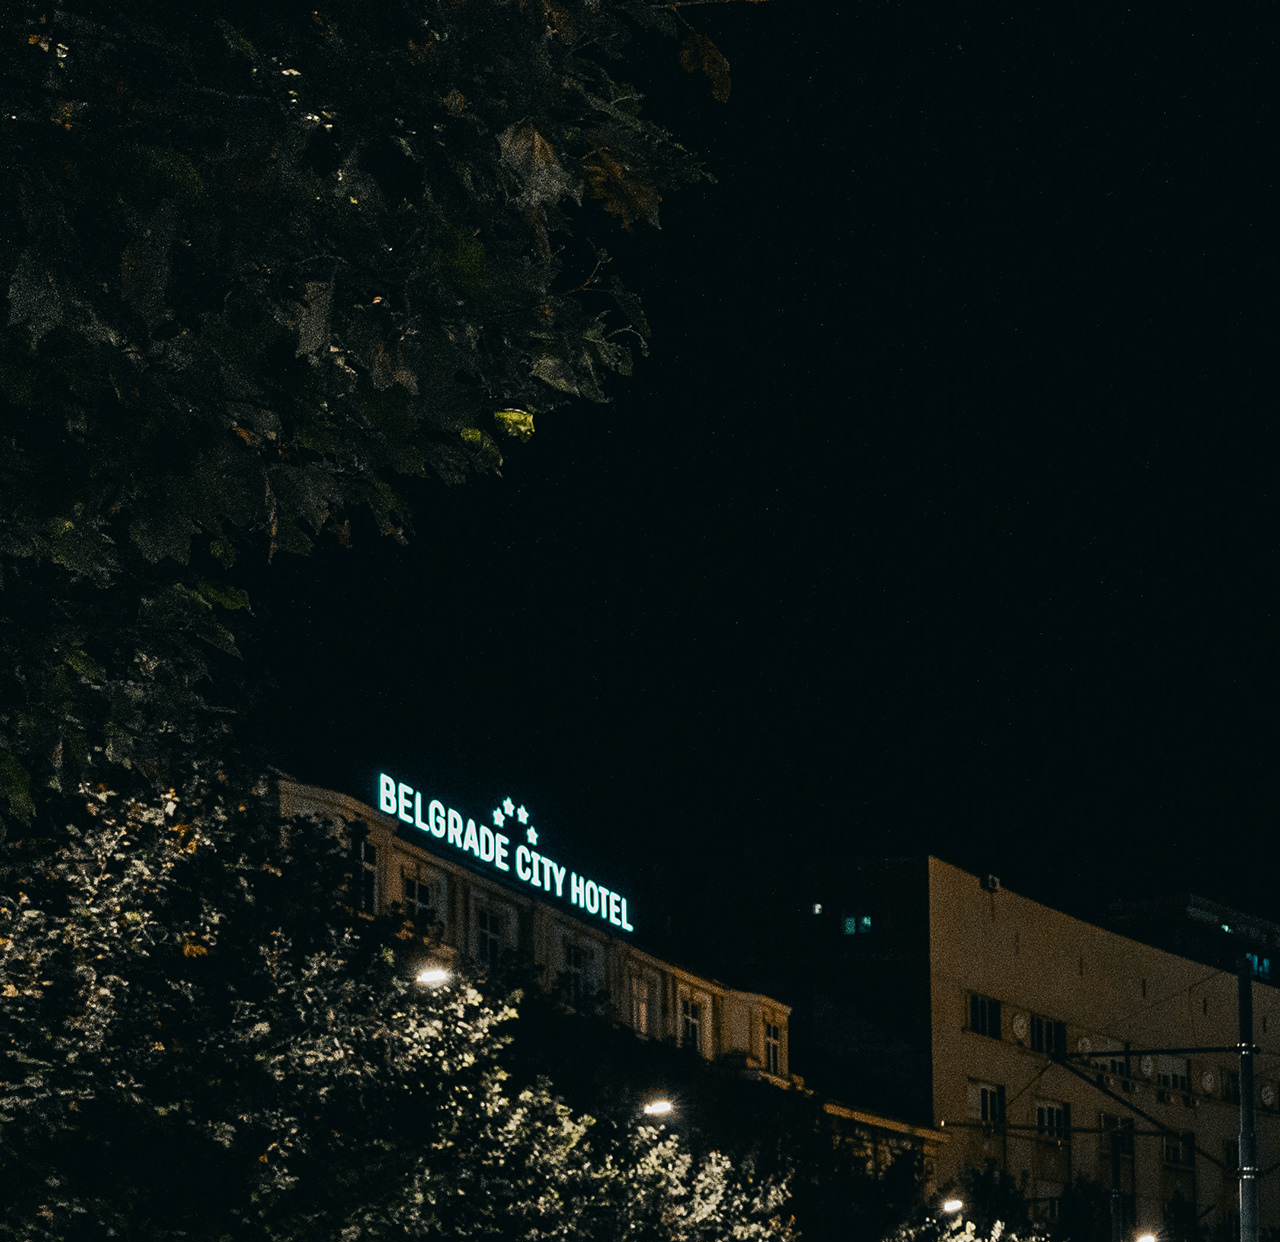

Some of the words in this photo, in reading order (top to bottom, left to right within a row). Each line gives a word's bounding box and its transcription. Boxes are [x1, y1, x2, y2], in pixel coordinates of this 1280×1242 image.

[379, 772, 510, 872] BELGRADE
[515, 844, 567, 897] CITY
[570, 871, 634, 932] HOTEL
